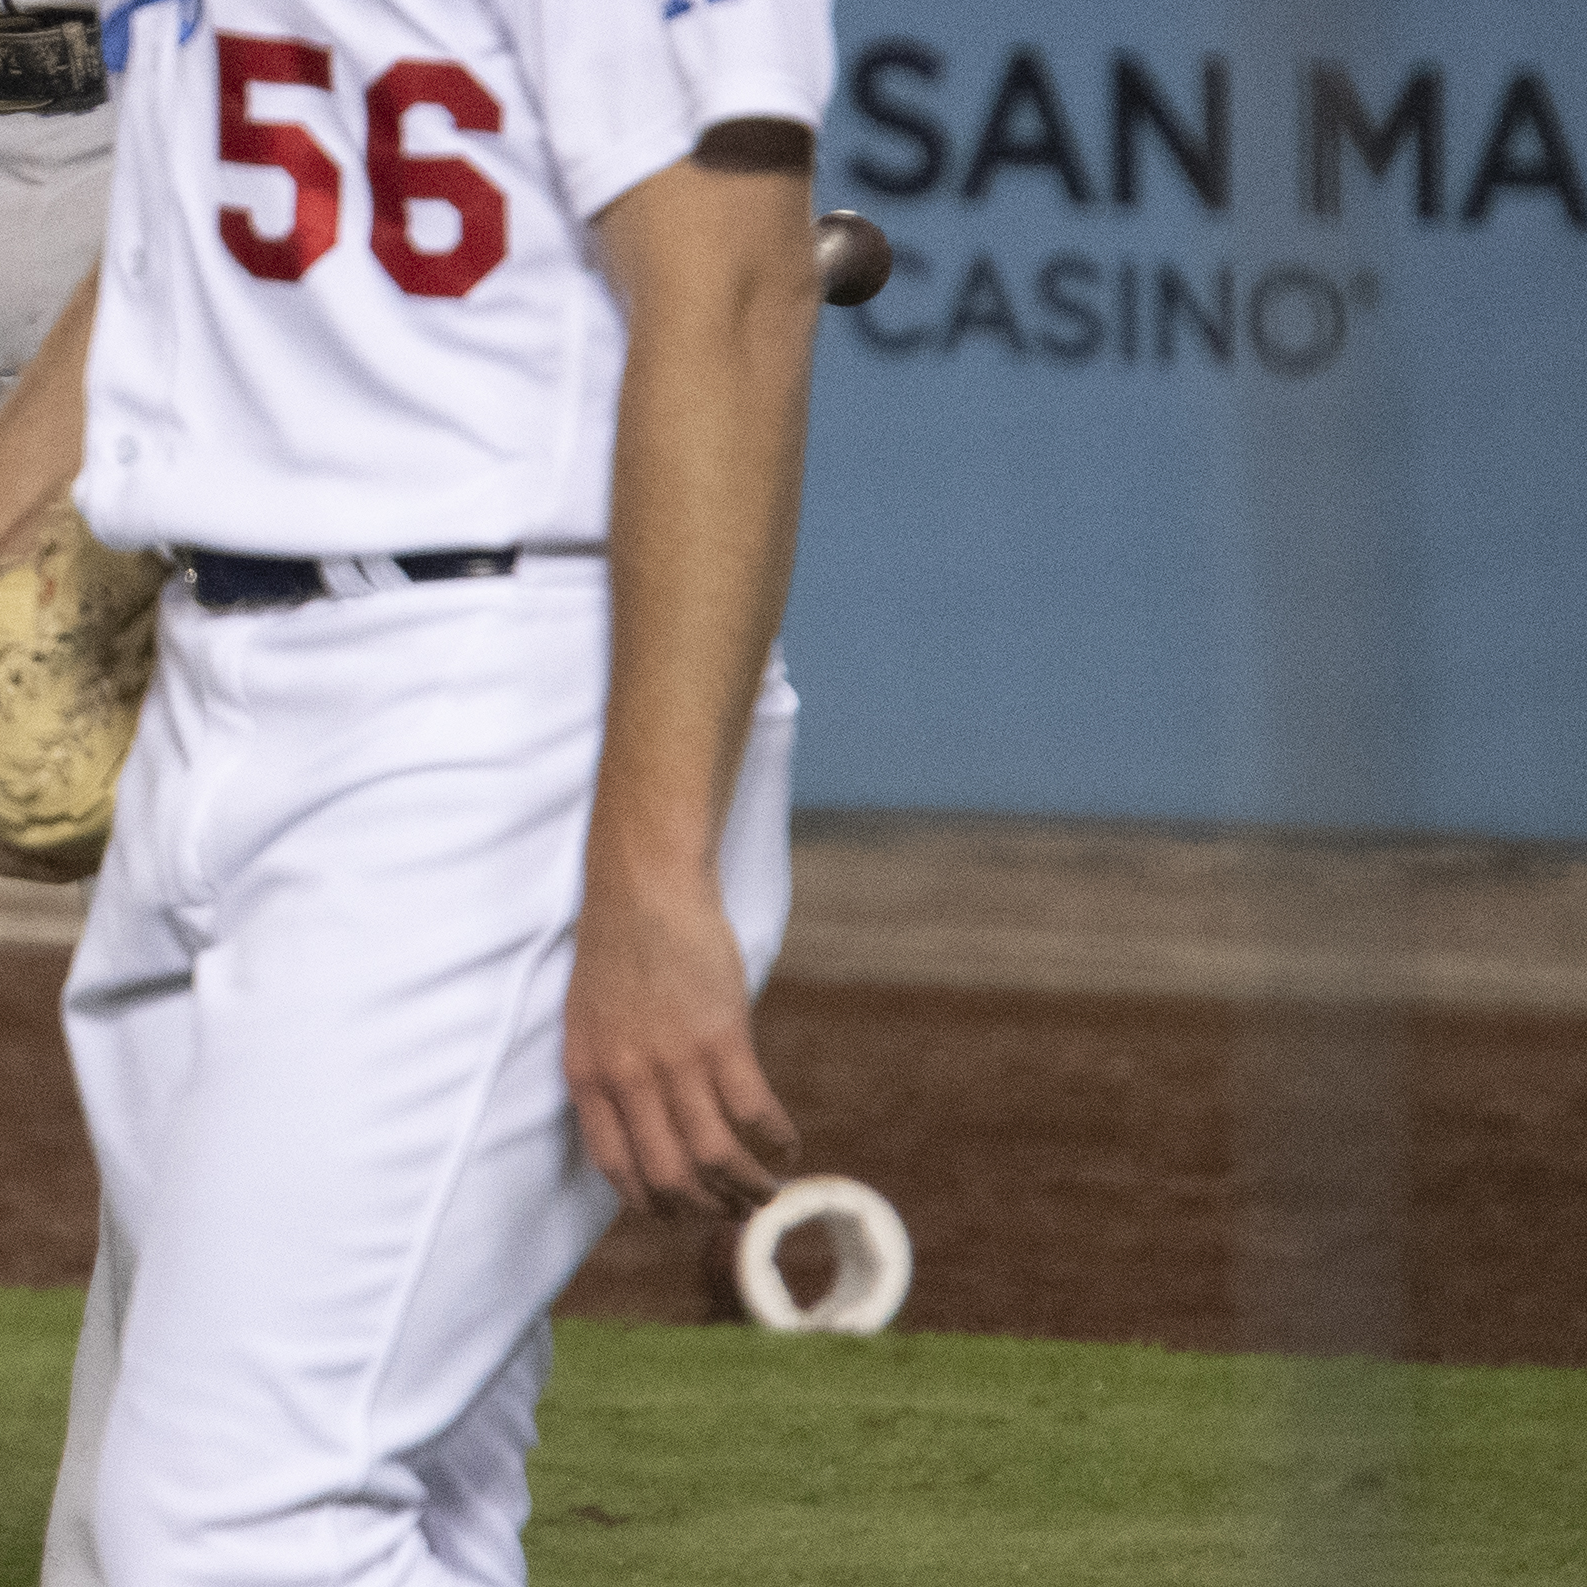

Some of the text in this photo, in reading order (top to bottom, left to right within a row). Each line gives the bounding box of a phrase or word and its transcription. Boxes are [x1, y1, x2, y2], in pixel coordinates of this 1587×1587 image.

[214, 30, 511, 298] 56
[845, 37, 1587, 229] SAN MA
